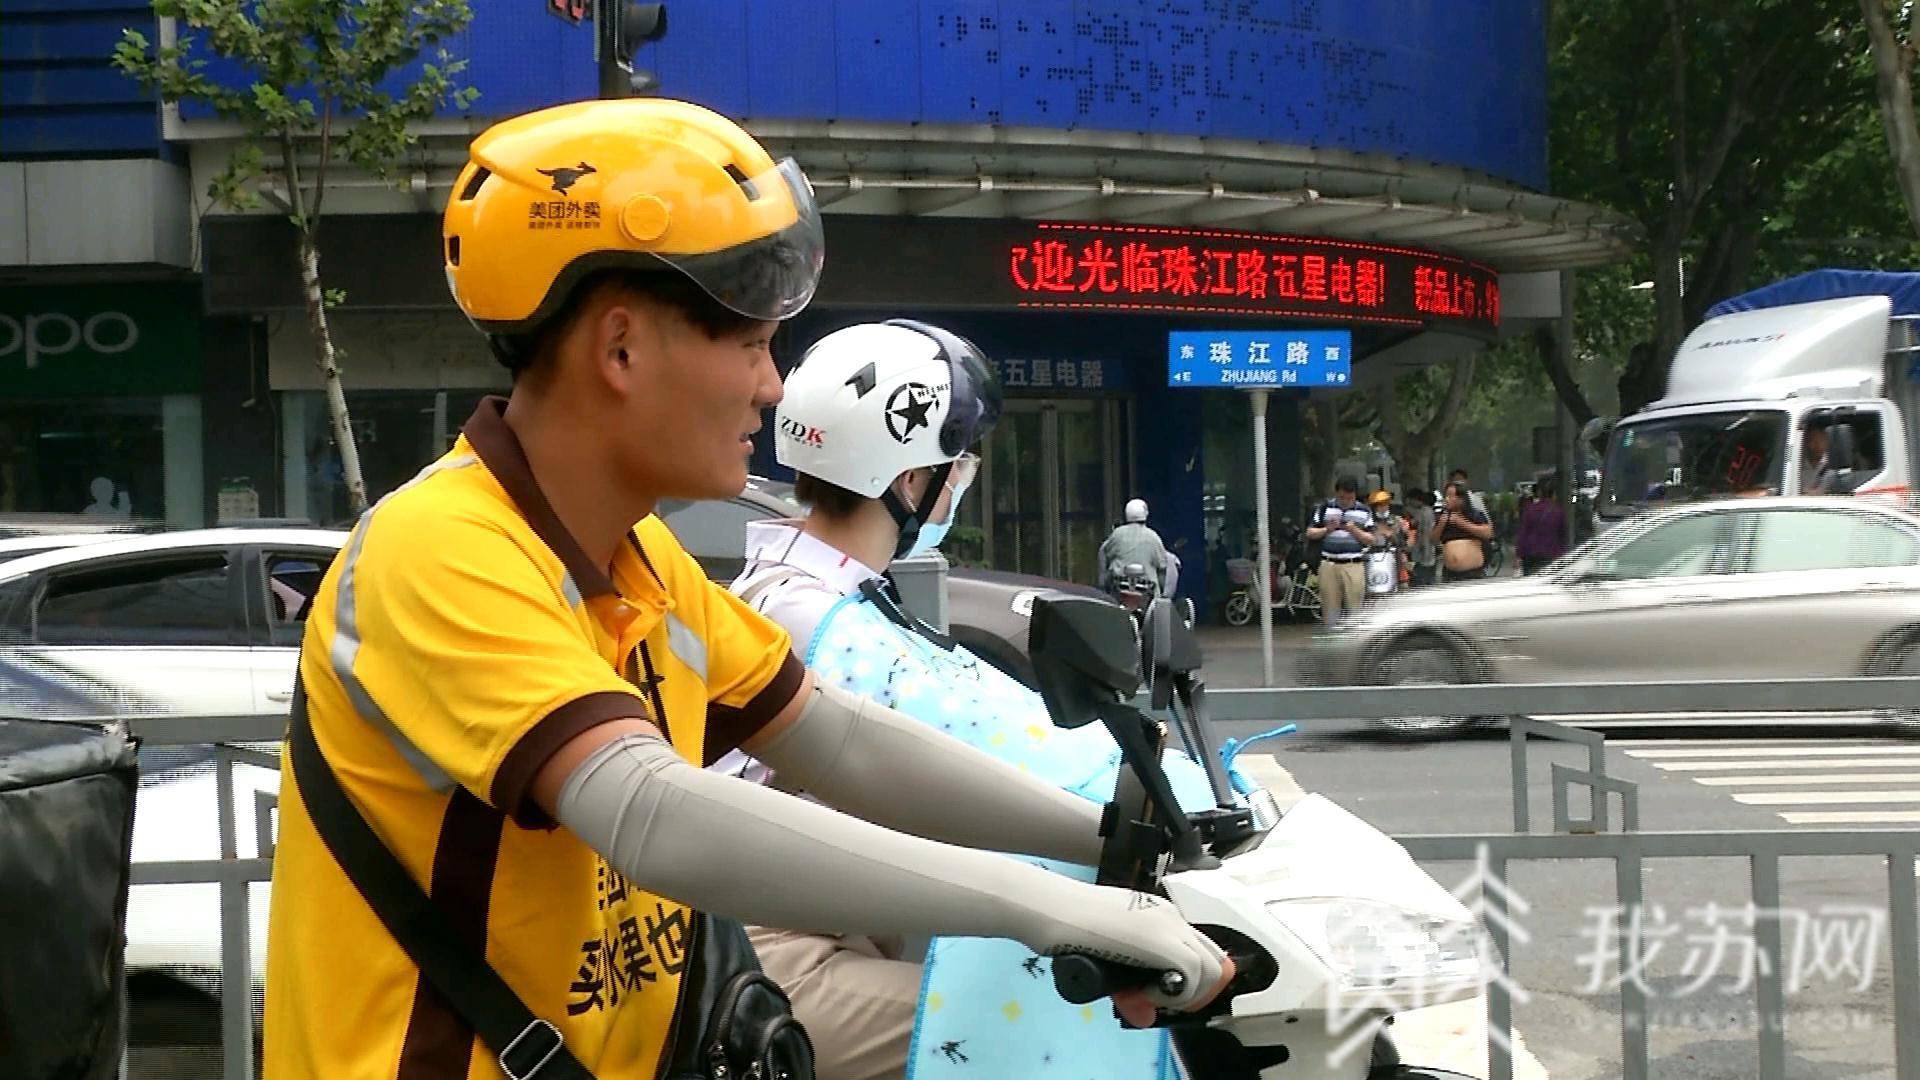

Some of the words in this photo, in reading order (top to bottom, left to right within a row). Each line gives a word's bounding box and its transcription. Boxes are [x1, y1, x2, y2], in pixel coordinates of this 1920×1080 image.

[528, 201, 600, 219] 美团外卖
[1180, 344, 1195, 360] 东
[1209, 340, 1309, 365] 珠江路
[1325, 346, 1341, 361] 西
[1182, 371, 1192, 382] E
[1220, 369, 1278, 383] ZHUJIANG
[1281, 369, 1297, 383] Rd
[1325, 371, 1337, 382] W
[781, 415, 825, 444] ZDK
